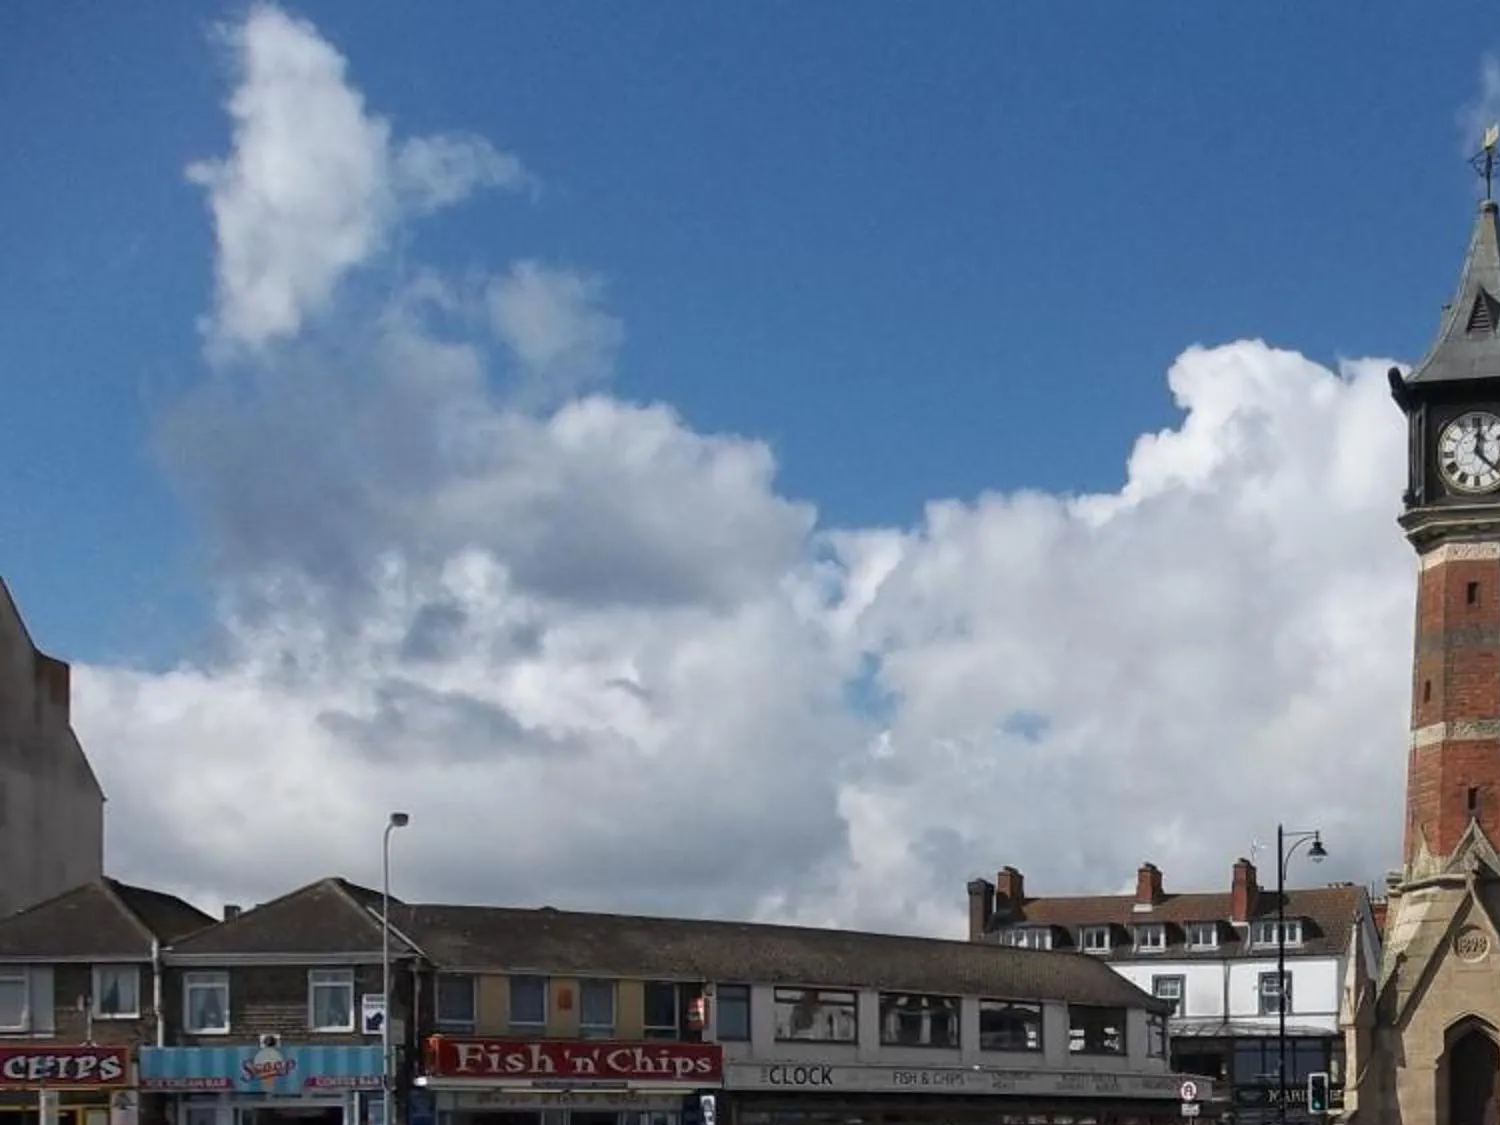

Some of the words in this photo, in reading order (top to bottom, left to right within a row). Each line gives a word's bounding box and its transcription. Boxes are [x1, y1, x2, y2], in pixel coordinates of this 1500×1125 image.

[453, 1043, 557, 1073] Fish
[607, 1048, 713, 1078] Chips
[769, 1065, 833, 1085] CLOCK
[893, 1071, 917, 1085] FISH
